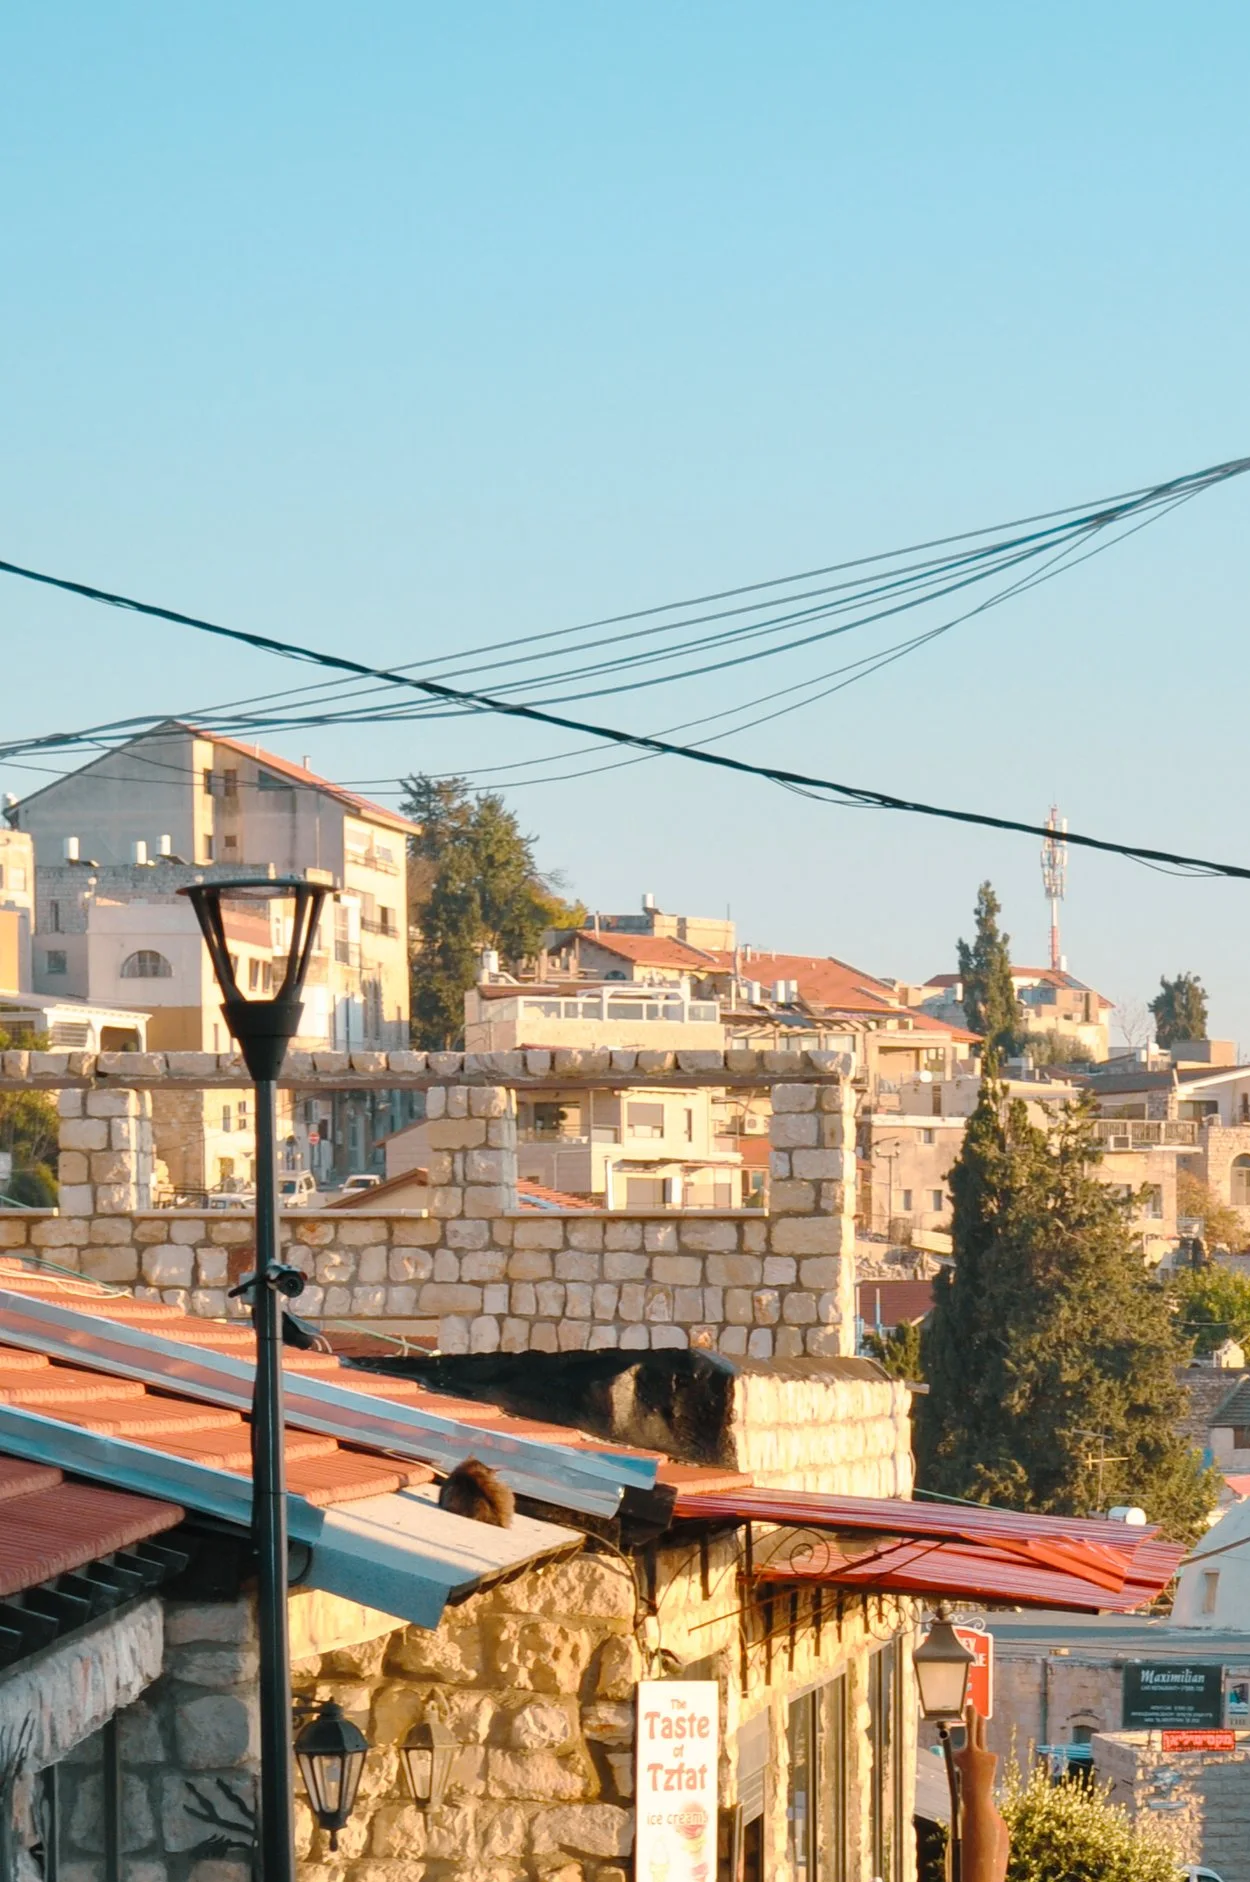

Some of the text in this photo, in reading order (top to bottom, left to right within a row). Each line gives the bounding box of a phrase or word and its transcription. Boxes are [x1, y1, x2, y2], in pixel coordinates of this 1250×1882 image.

[1140, 1668, 1205, 1684] Maximilian
[671, 1698, 687, 1710] The
[644, 1712, 710, 1740] Taste
[1228, 1718, 1246, 1727] THE
[672, 1744, 685, 1759] of
[647, 1763, 709, 1792] Tzfat
[647, 1811, 663, 1826] ice
